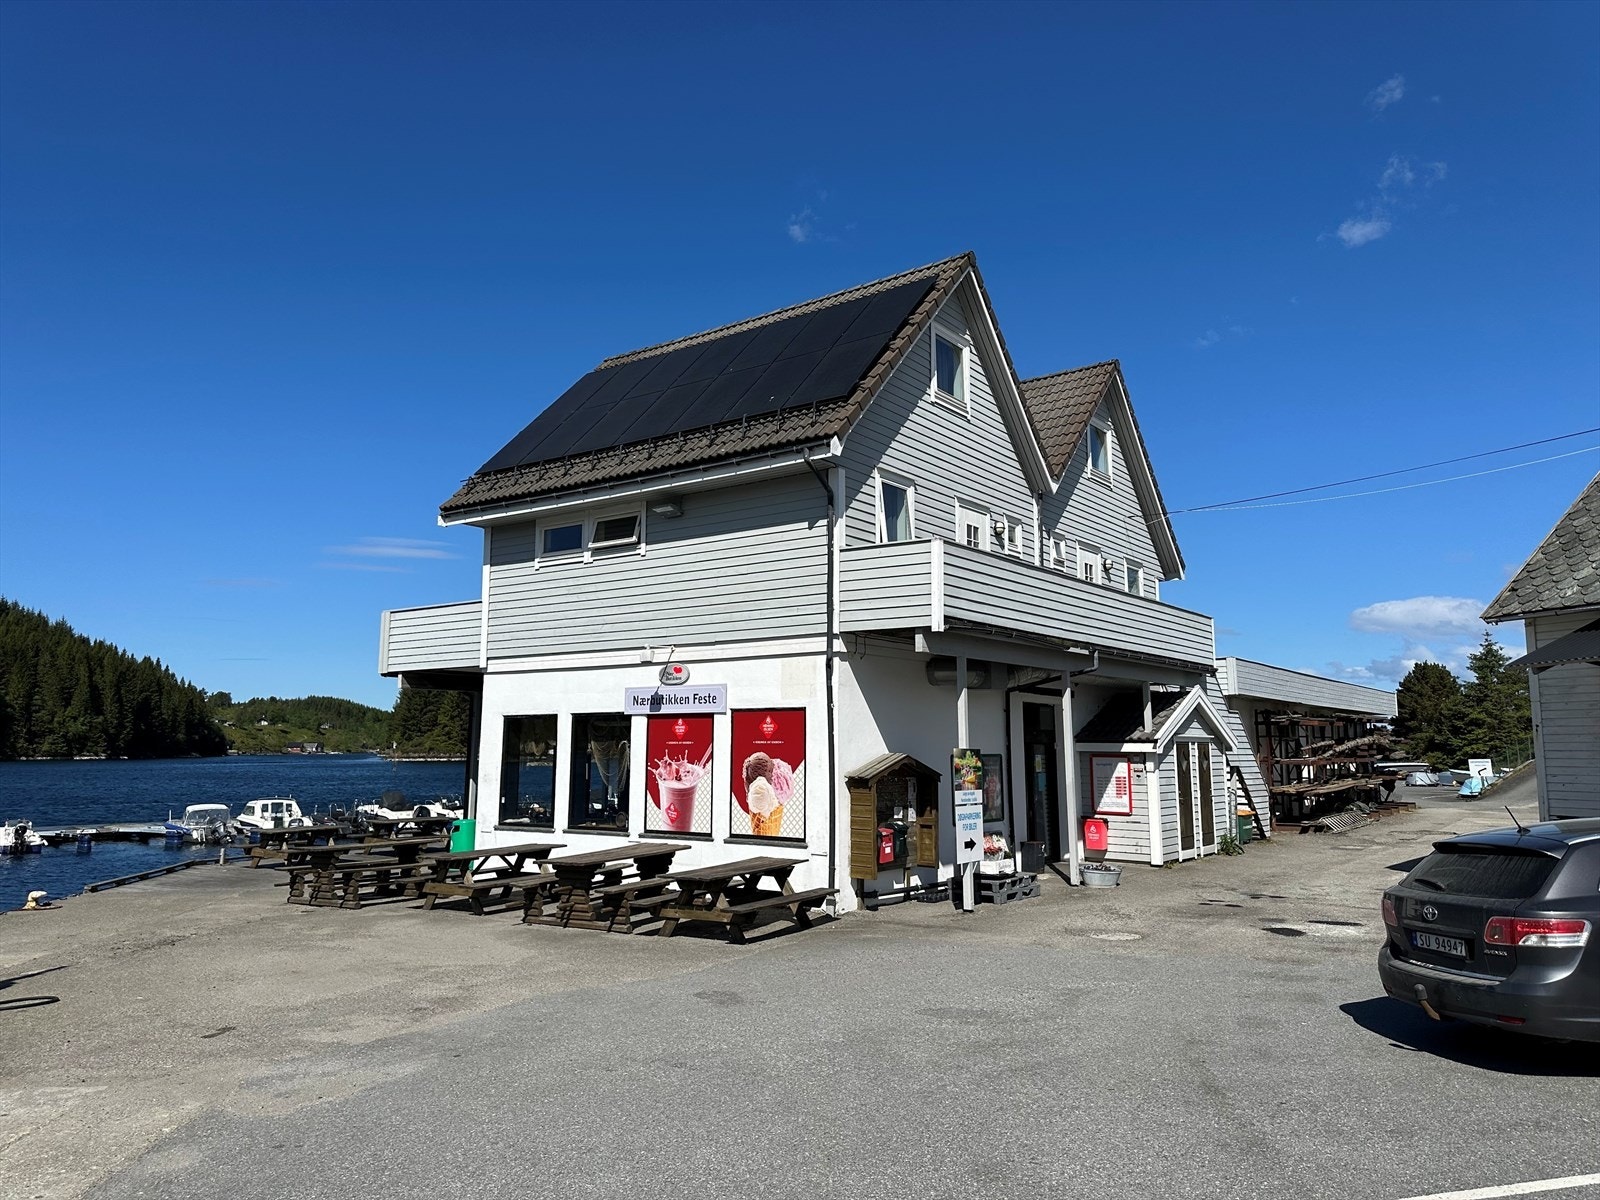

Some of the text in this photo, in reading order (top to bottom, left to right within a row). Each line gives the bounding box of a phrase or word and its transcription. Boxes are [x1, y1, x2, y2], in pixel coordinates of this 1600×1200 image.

[632, 693, 717, 706] Nærbutikken Feste
[1420, 934, 1463, 954] SU 94947
